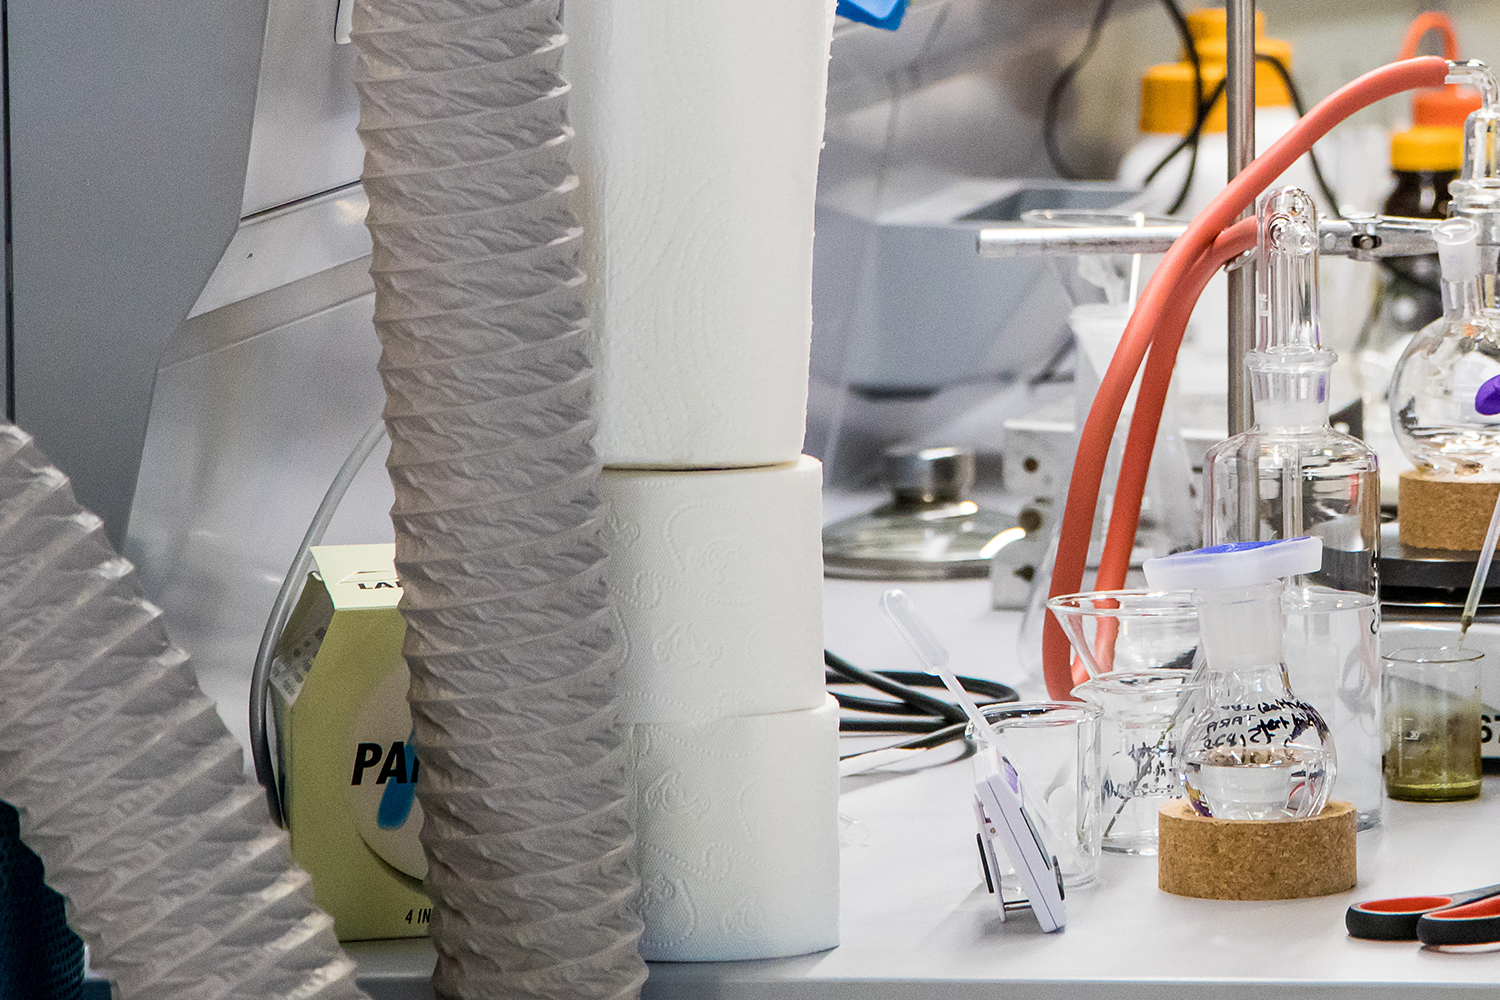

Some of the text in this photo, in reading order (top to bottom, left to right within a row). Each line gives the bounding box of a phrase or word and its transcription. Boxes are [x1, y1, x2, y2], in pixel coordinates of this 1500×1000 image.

[357, 580, 402, 590] LA
[351, 740, 420, 786] PA
[405, 909, 413, 925] 4
